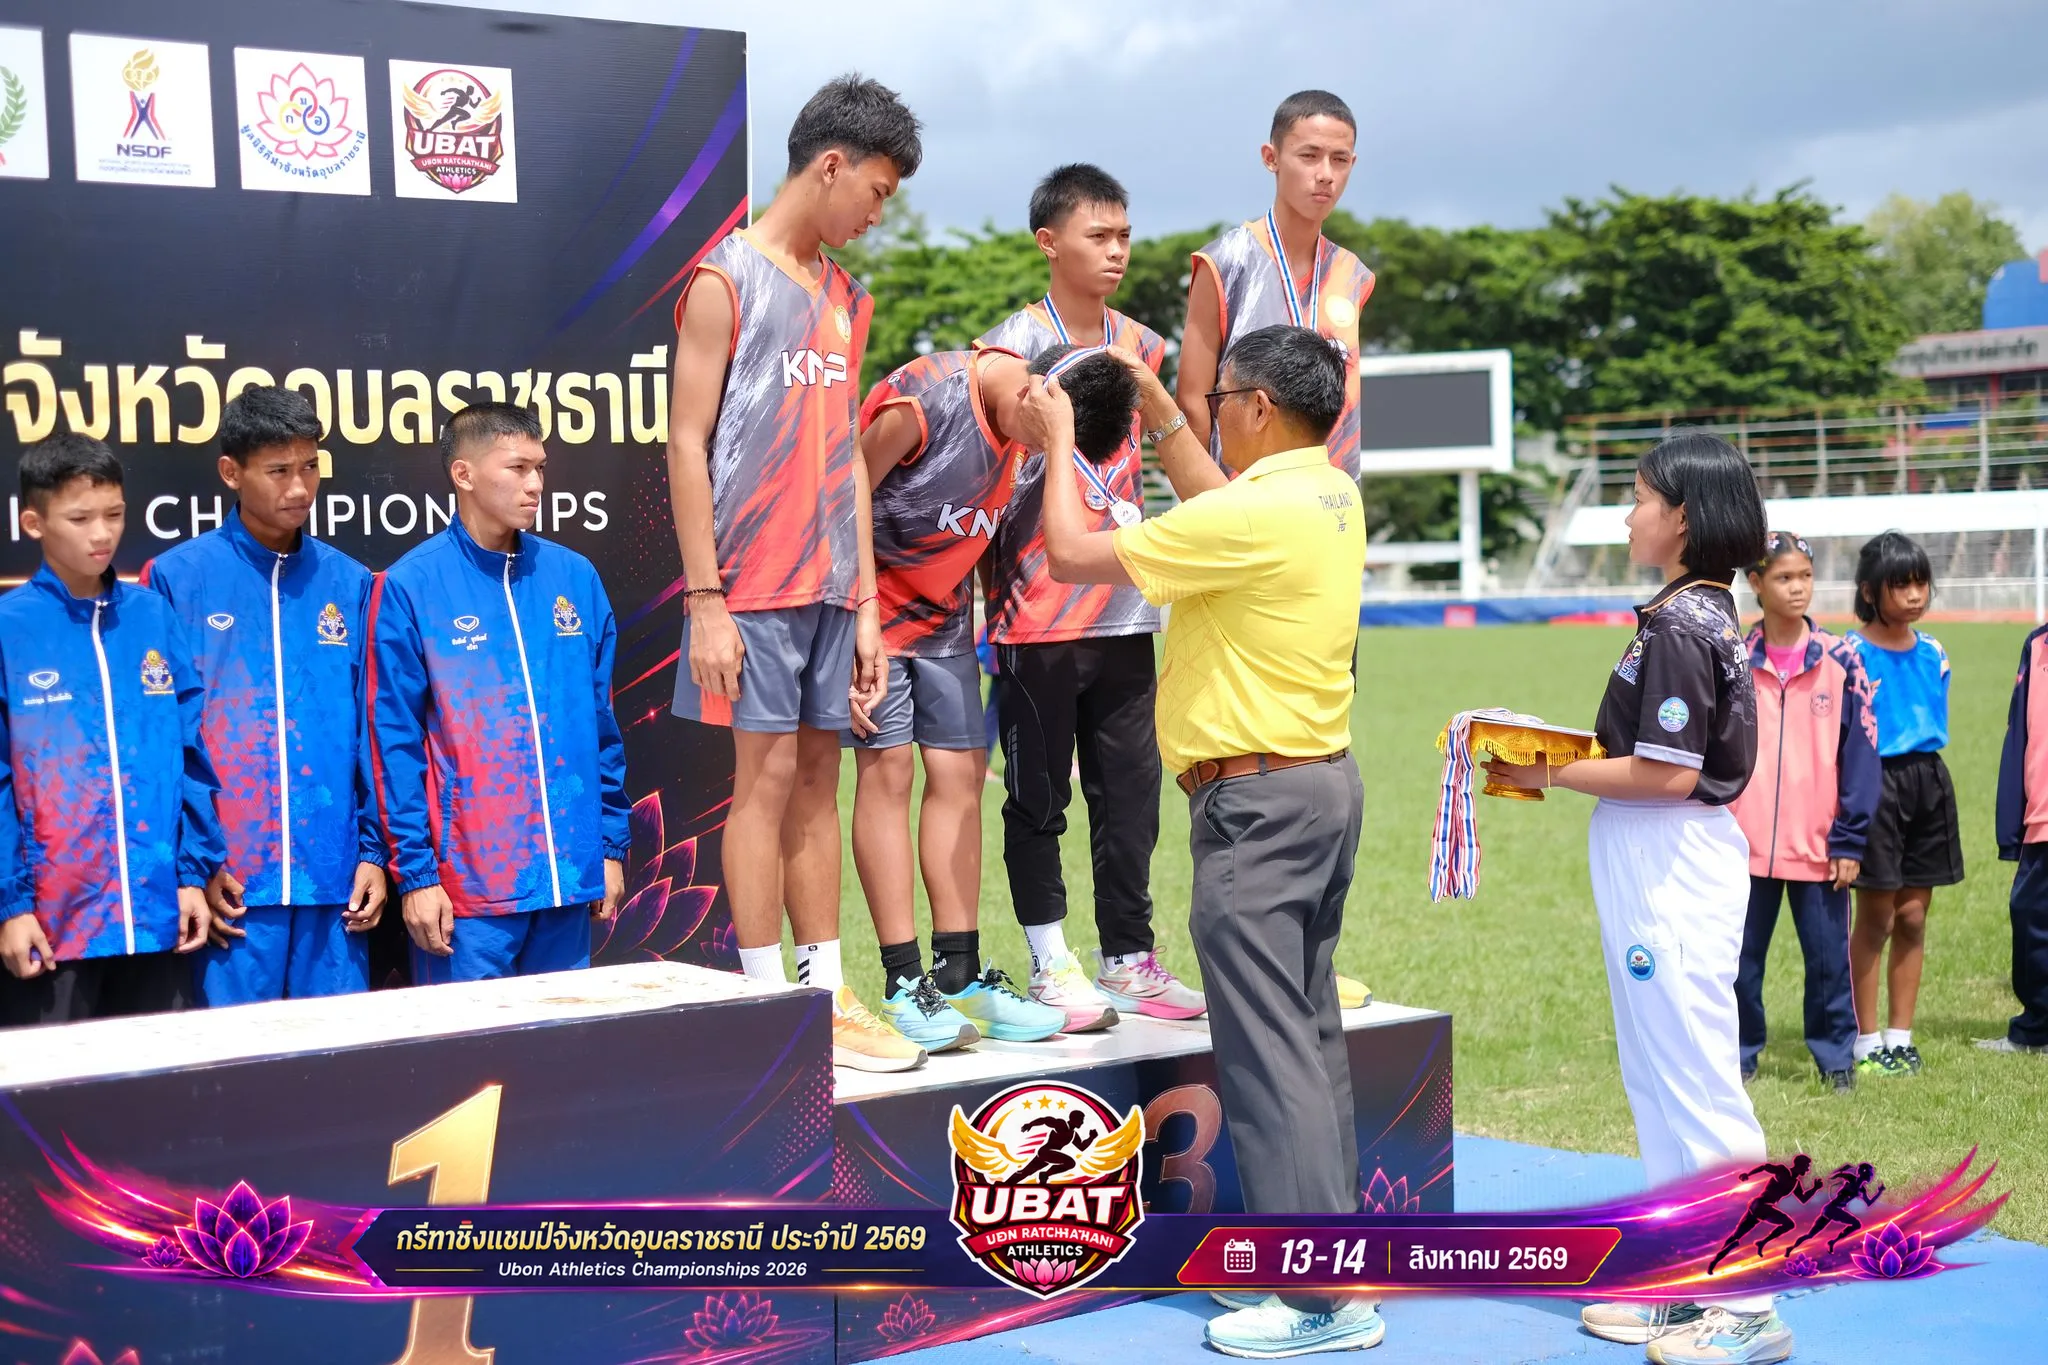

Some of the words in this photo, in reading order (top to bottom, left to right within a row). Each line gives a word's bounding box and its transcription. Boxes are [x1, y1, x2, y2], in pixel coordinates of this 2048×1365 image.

[116, 143, 173, 159] NSDF
[413, 131, 497, 159] UBAT
[421, 158, 443, 167] UBON
[443, 158, 493, 171] RATCHATHANI
[436, 166, 477, 175] ATHLETICS
[780, 348, 848, 389] KNP
[145, 490, 610, 540] CHPIONIPS
[1318, 492, 1353, 511] THAILAND
[936, 503, 1008, 541] KN
[388, 1085, 503, 1365] 1
[1289, 1312, 1335, 1338] HOKA
